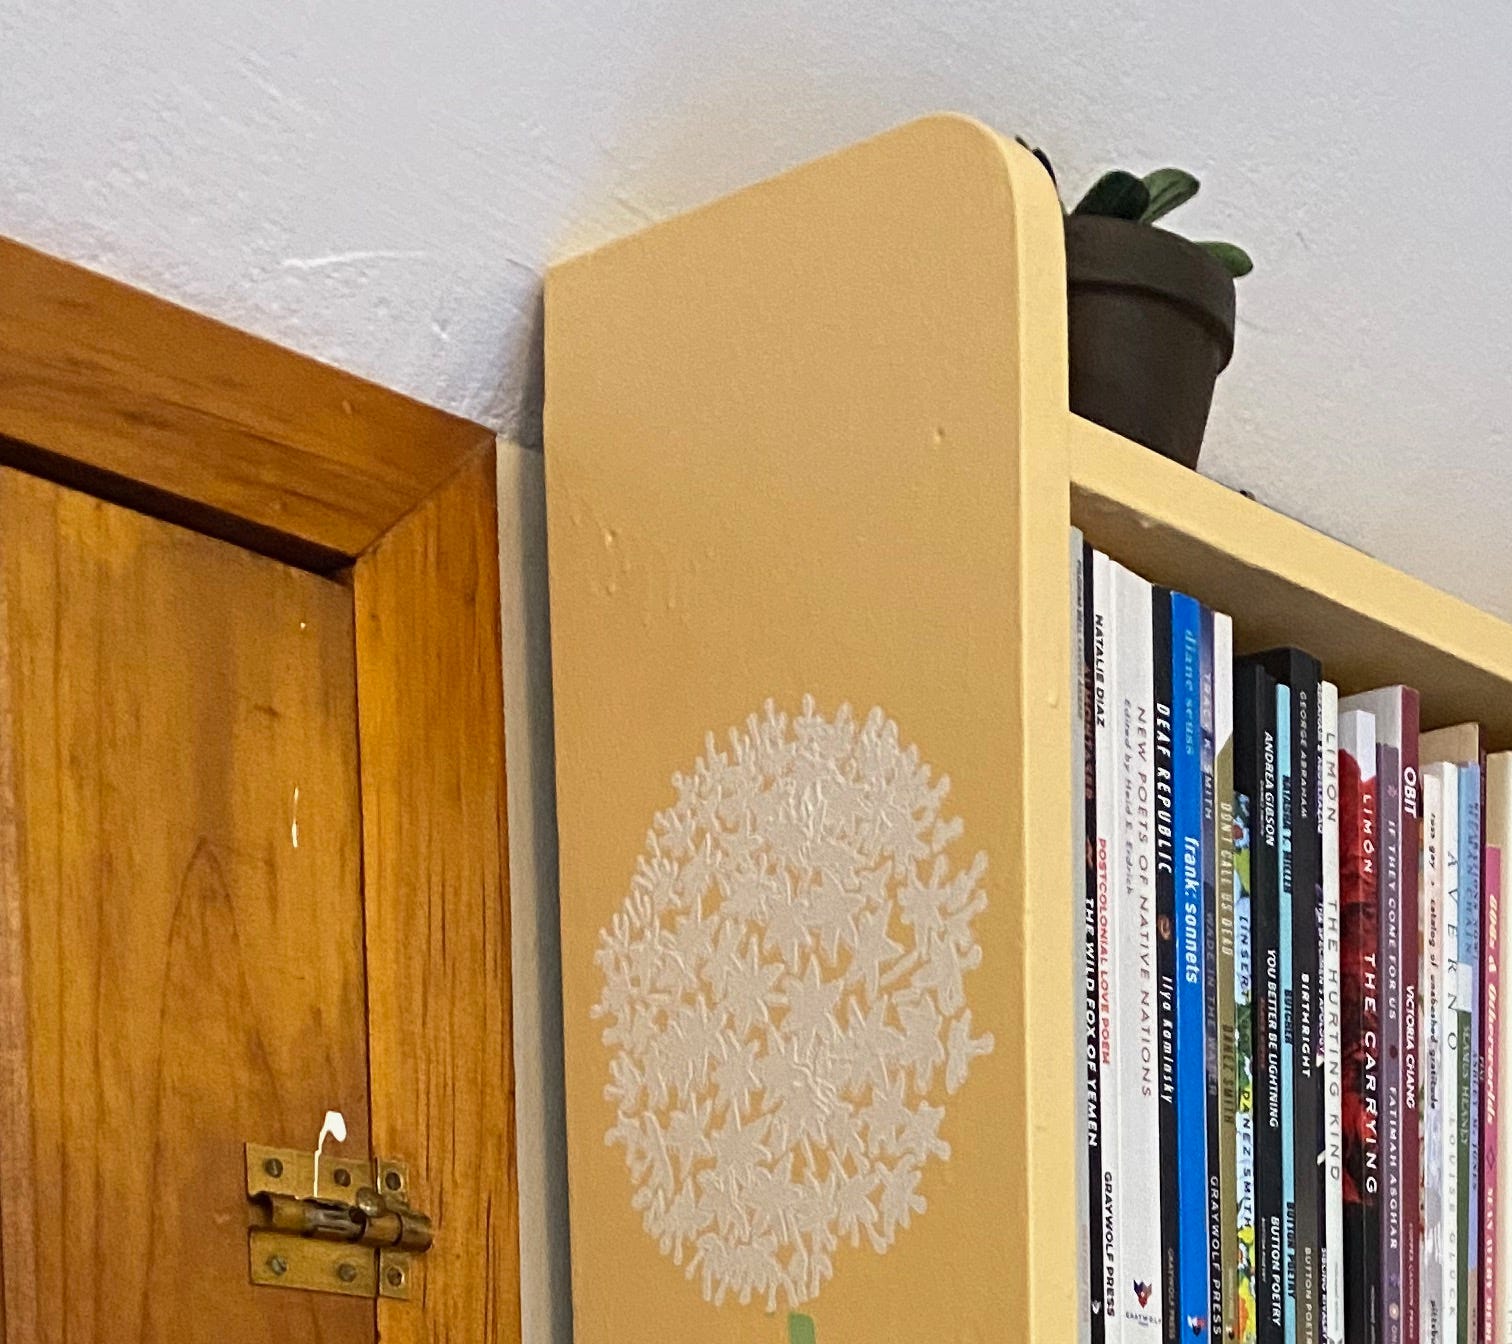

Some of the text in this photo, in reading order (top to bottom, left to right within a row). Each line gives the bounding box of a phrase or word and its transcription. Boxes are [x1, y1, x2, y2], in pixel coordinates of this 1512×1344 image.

[1095, 615, 1105, 683] NATALIE
[1096, 686, 1106, 728] DIAZ
[1156, 702, 1172, 875] DEAF REPUBLIC
[1264, 732, 1275, 846] ANDREA GIBSON
[1098, 838, 1111, 1065] POSTCOLONIAL LOVE POEM
[1137, 706, 1152, 1097] NEW POETS OF NATIVE NATIONS
[1183, 836, 1200, 984] frank: sonnets
[1388, 820, 1397, 1019] IF THEY COME FOR US
[1404, 767, 1416, 1109] OBIT VICTORIA CHANG
[1085, 898, 1098, 1147] THE WILD FOX OF YEMEN
[1160, 975, 1175, 1104] Ilya Kaminsky
[1268, 949, 1279, 1128] YOU BETTER BE LIGHTNING
[1300, 973, 1311, 1078] BIRTHRIGHT
[1363, 794, 1377, 1194] LIMÓN THE CARRYING
[1103, 1171, 1115, 1316] GRAYWOLF PRESS
[1388, 1087, 1398, 1249] FATIMAH ASGHAR
[1210, 1176, 1223, 1336] GRAYWOLF PRESS
[1270, 1217, 1281, 1326] BUTTON POETRY
